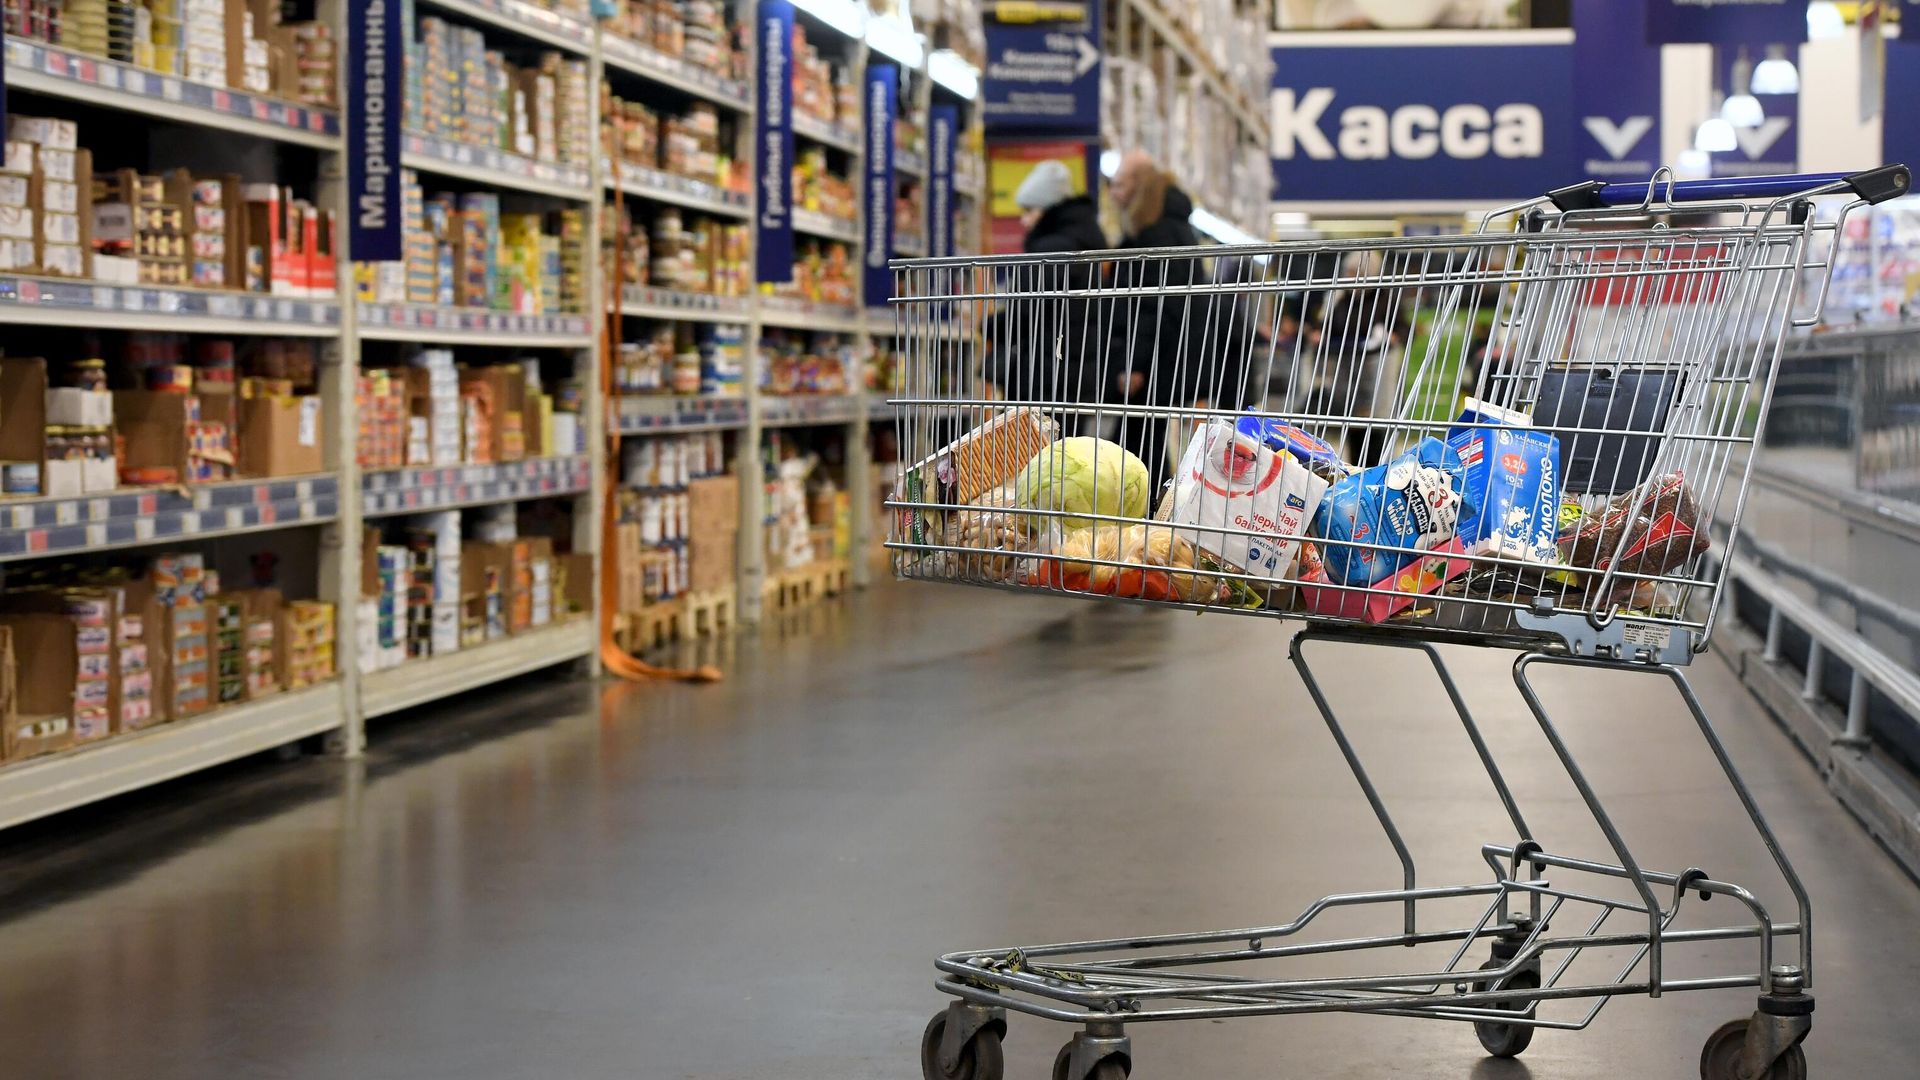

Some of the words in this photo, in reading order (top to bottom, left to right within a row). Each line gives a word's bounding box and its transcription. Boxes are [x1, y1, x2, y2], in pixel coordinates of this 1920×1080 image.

[1270, 87, 1544, 160] Касса
[1514, 433, 1550, 448] КАЗАНСКИ
[1505, 475, 1524, 485] ГОТ
[1290, 496, 1303, 506] aro
[1428, 487, 1448, 508] 3
[1541, 457, 1553, 534] МОЛОКО
[1279, 511, 1298, 529] Чай
[1234, 515, 1288, 549] байхый
[1251, 537, 1284, 557] ПАКЕТИАХ
